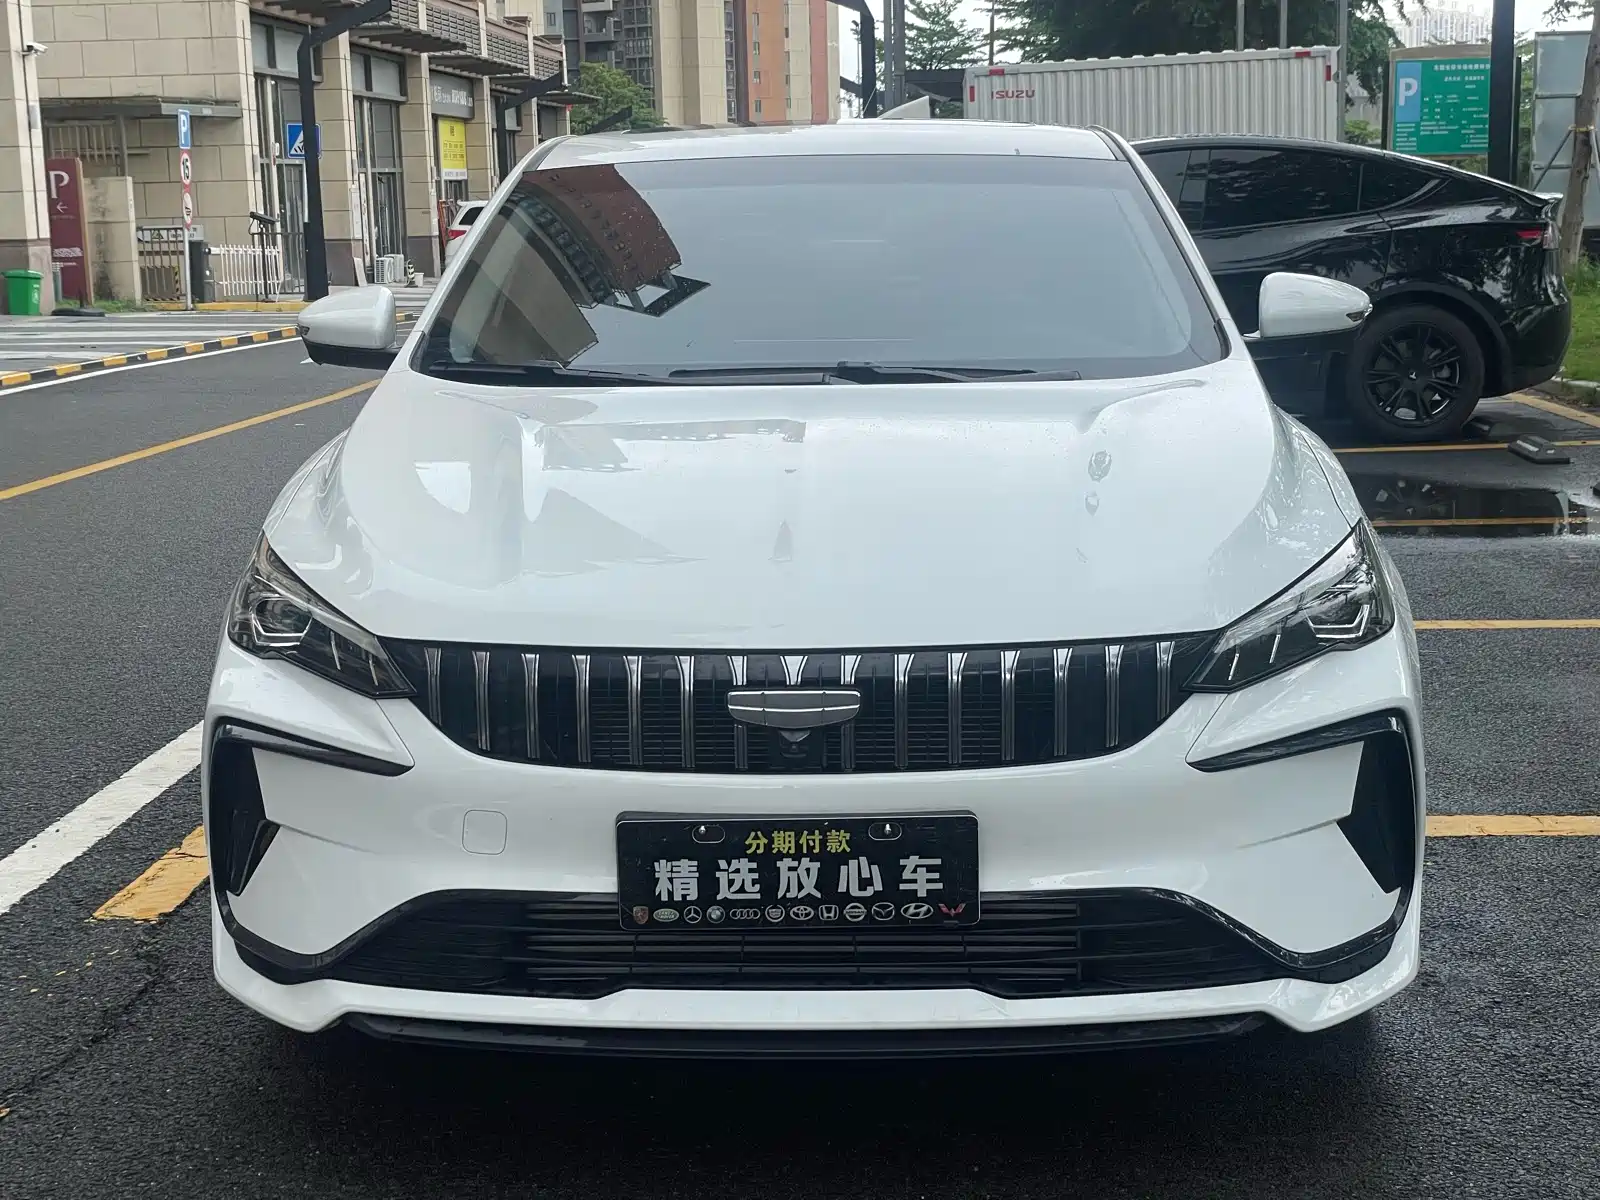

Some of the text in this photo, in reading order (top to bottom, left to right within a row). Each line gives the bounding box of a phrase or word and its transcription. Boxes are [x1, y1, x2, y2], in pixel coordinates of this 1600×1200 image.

[991, 89, 1036, 100] ISUZU
[1398, 77, 1418, 106] P
[180, 114, 188, 144] P
[182, 158, 190, 180] 15
[48, 170, 70, 199] P
[744, 829, 851, 854] 分期付款
[653, 855, 944, 901] 精选放心车
